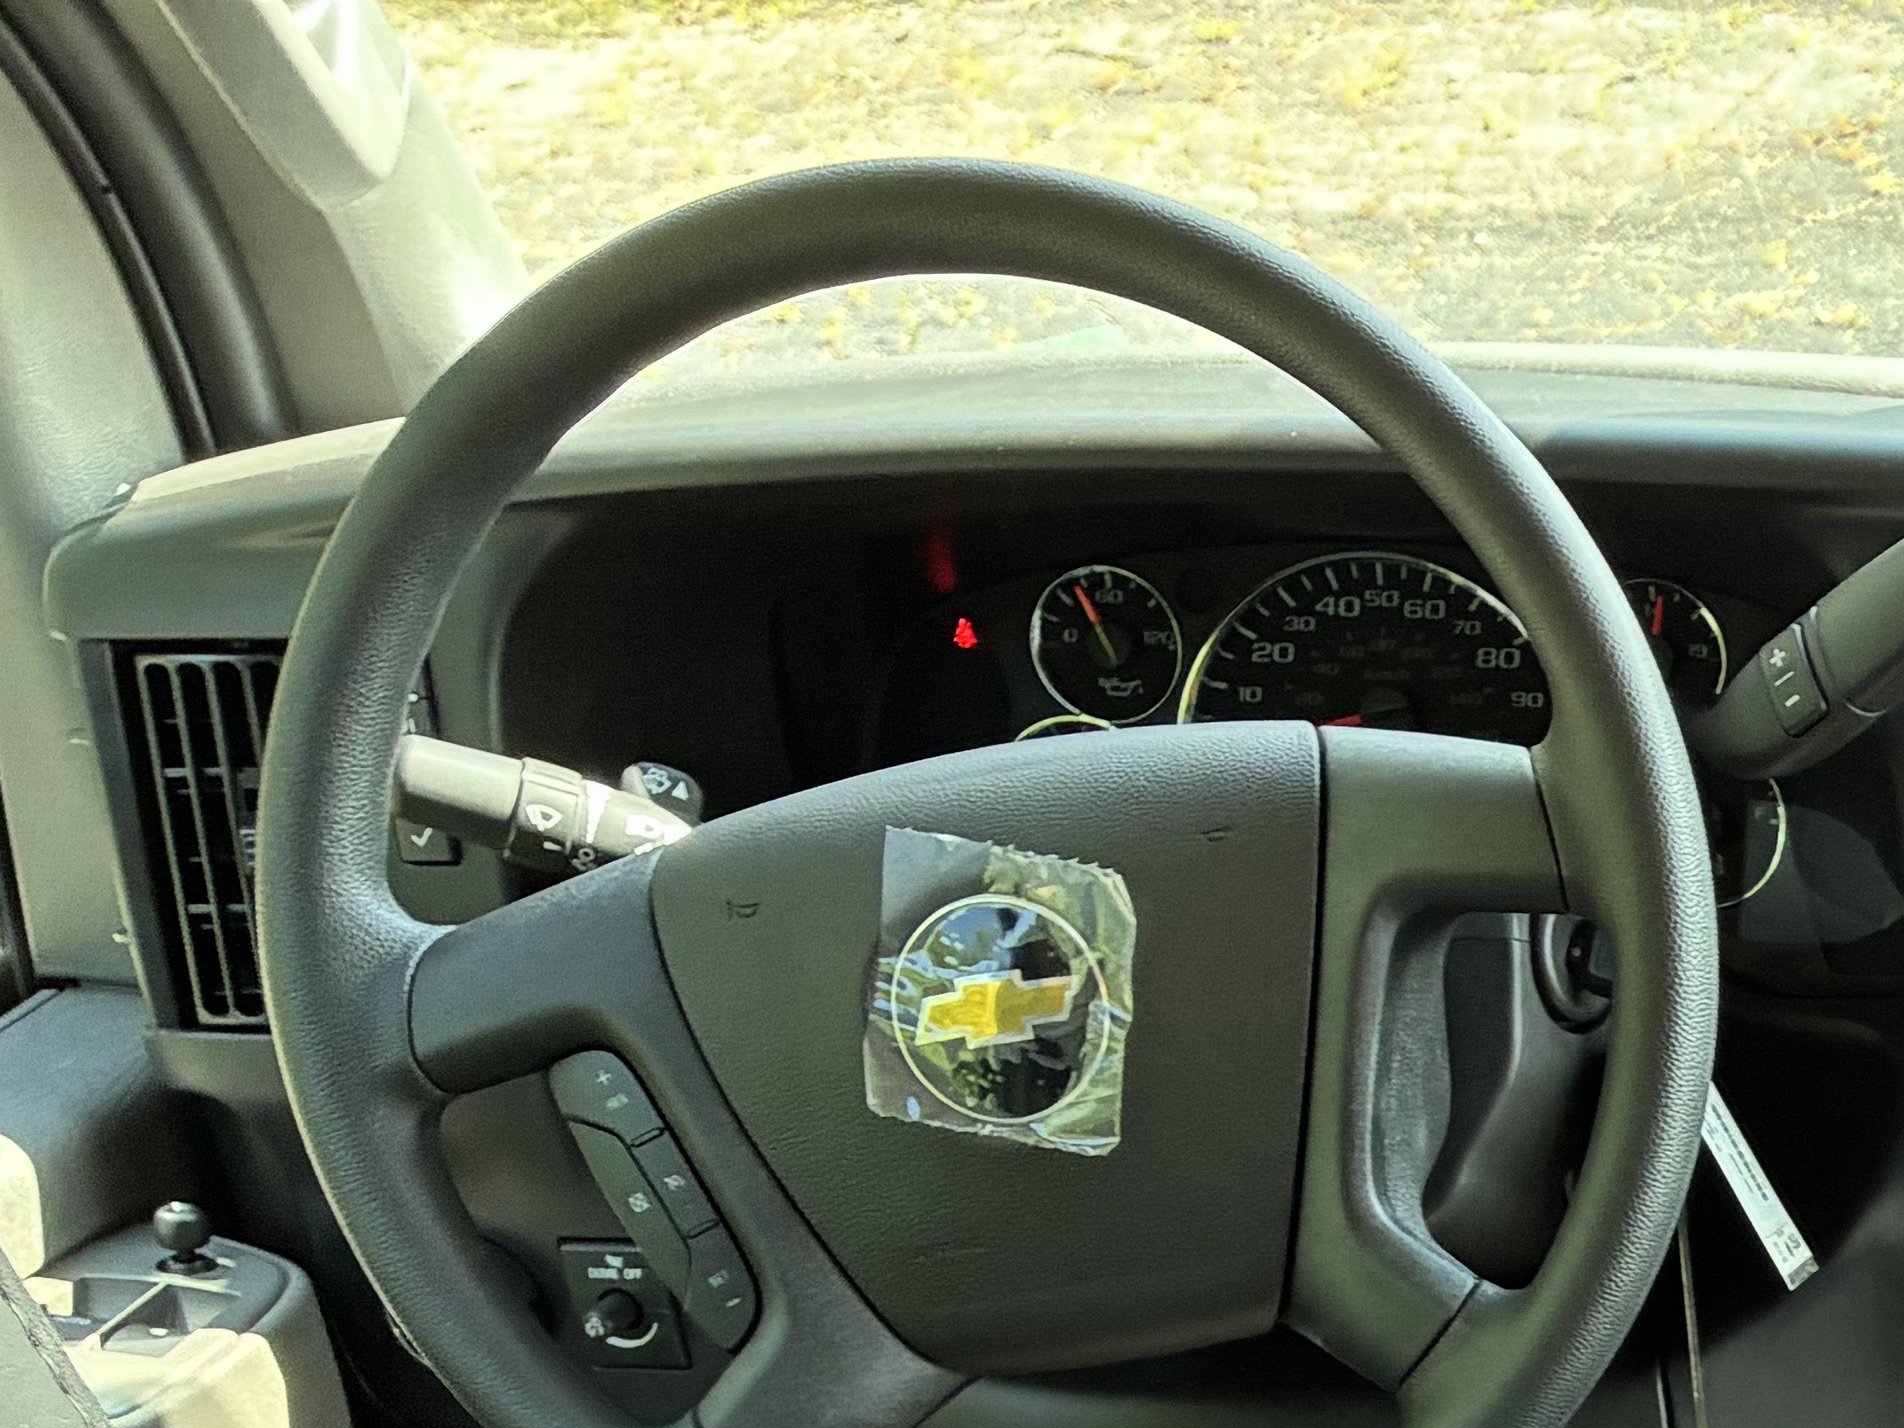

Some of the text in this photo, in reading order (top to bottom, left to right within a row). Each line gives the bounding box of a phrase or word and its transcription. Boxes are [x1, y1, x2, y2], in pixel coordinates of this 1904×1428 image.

[1314, 595, 1361, 618] 40
[1364, 589, 1400, 608] 50
[1403, 598, 1447, 620] 60
[1285, 615, 1316, 632] 30
[1452, 619, 1482, 636] 70
[1251, 641, 1297, 664] 20
[1475, 647, 1522, 669] 80
[1240, 686, 1264, 702] 10
[1510, 691, 1545, 709] 90
